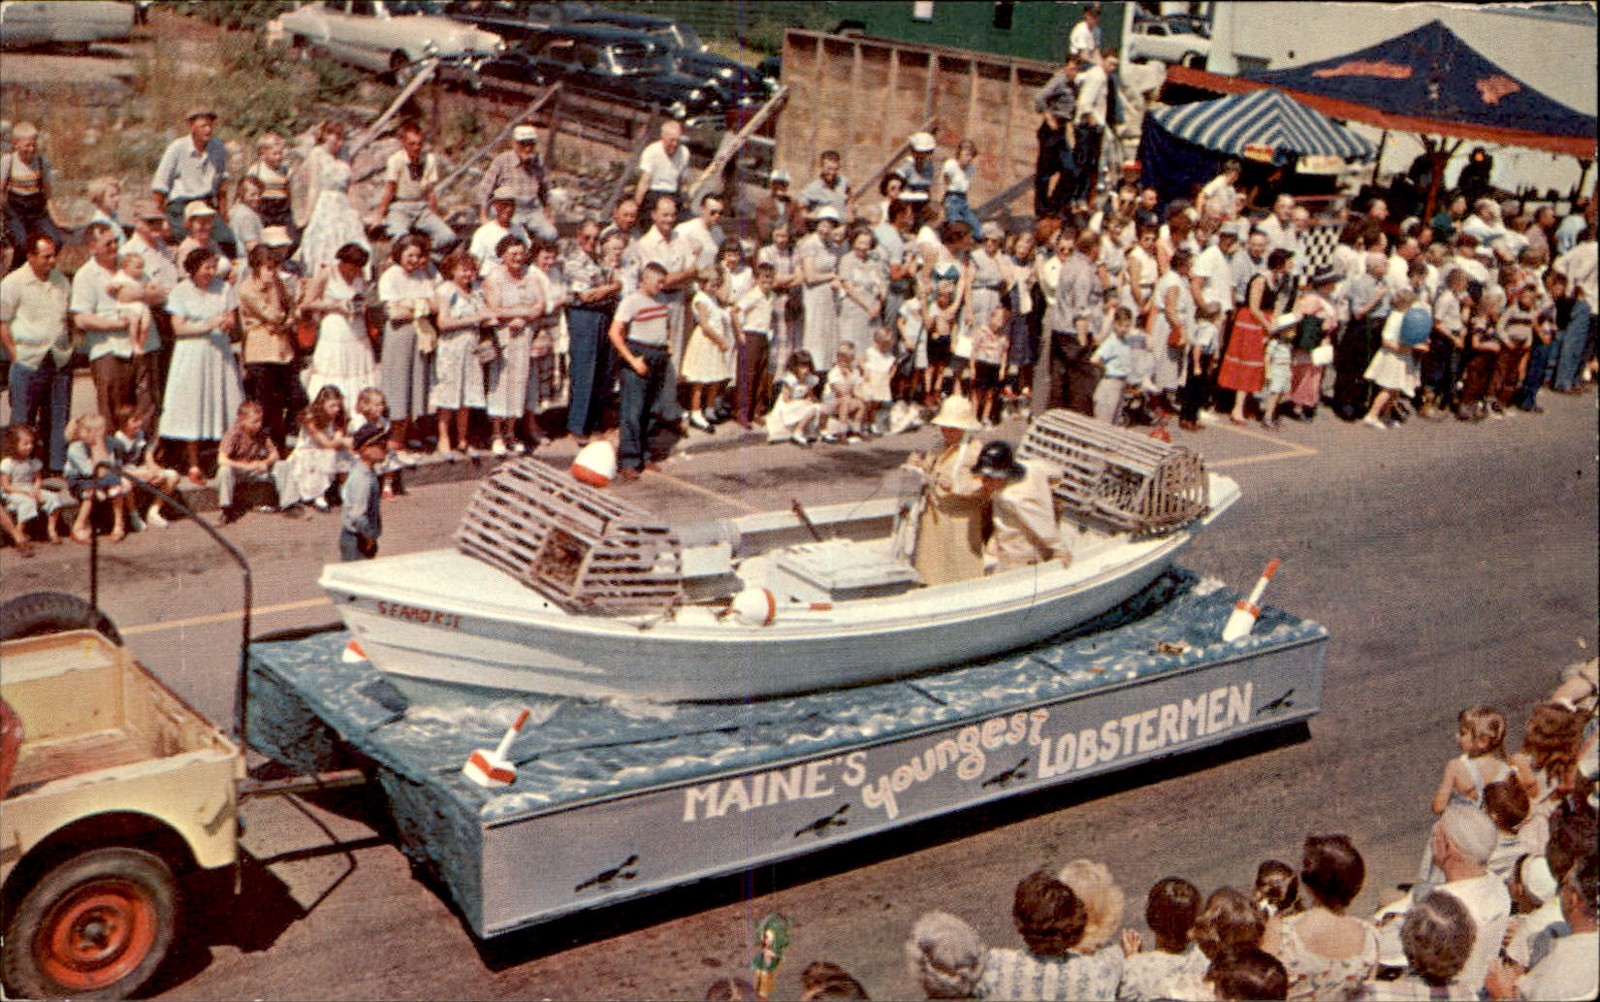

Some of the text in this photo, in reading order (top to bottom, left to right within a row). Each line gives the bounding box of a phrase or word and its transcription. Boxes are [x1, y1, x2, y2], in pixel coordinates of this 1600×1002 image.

[682, 683, 1253, 822] MAINE'S youngest LOBSTERMEN
